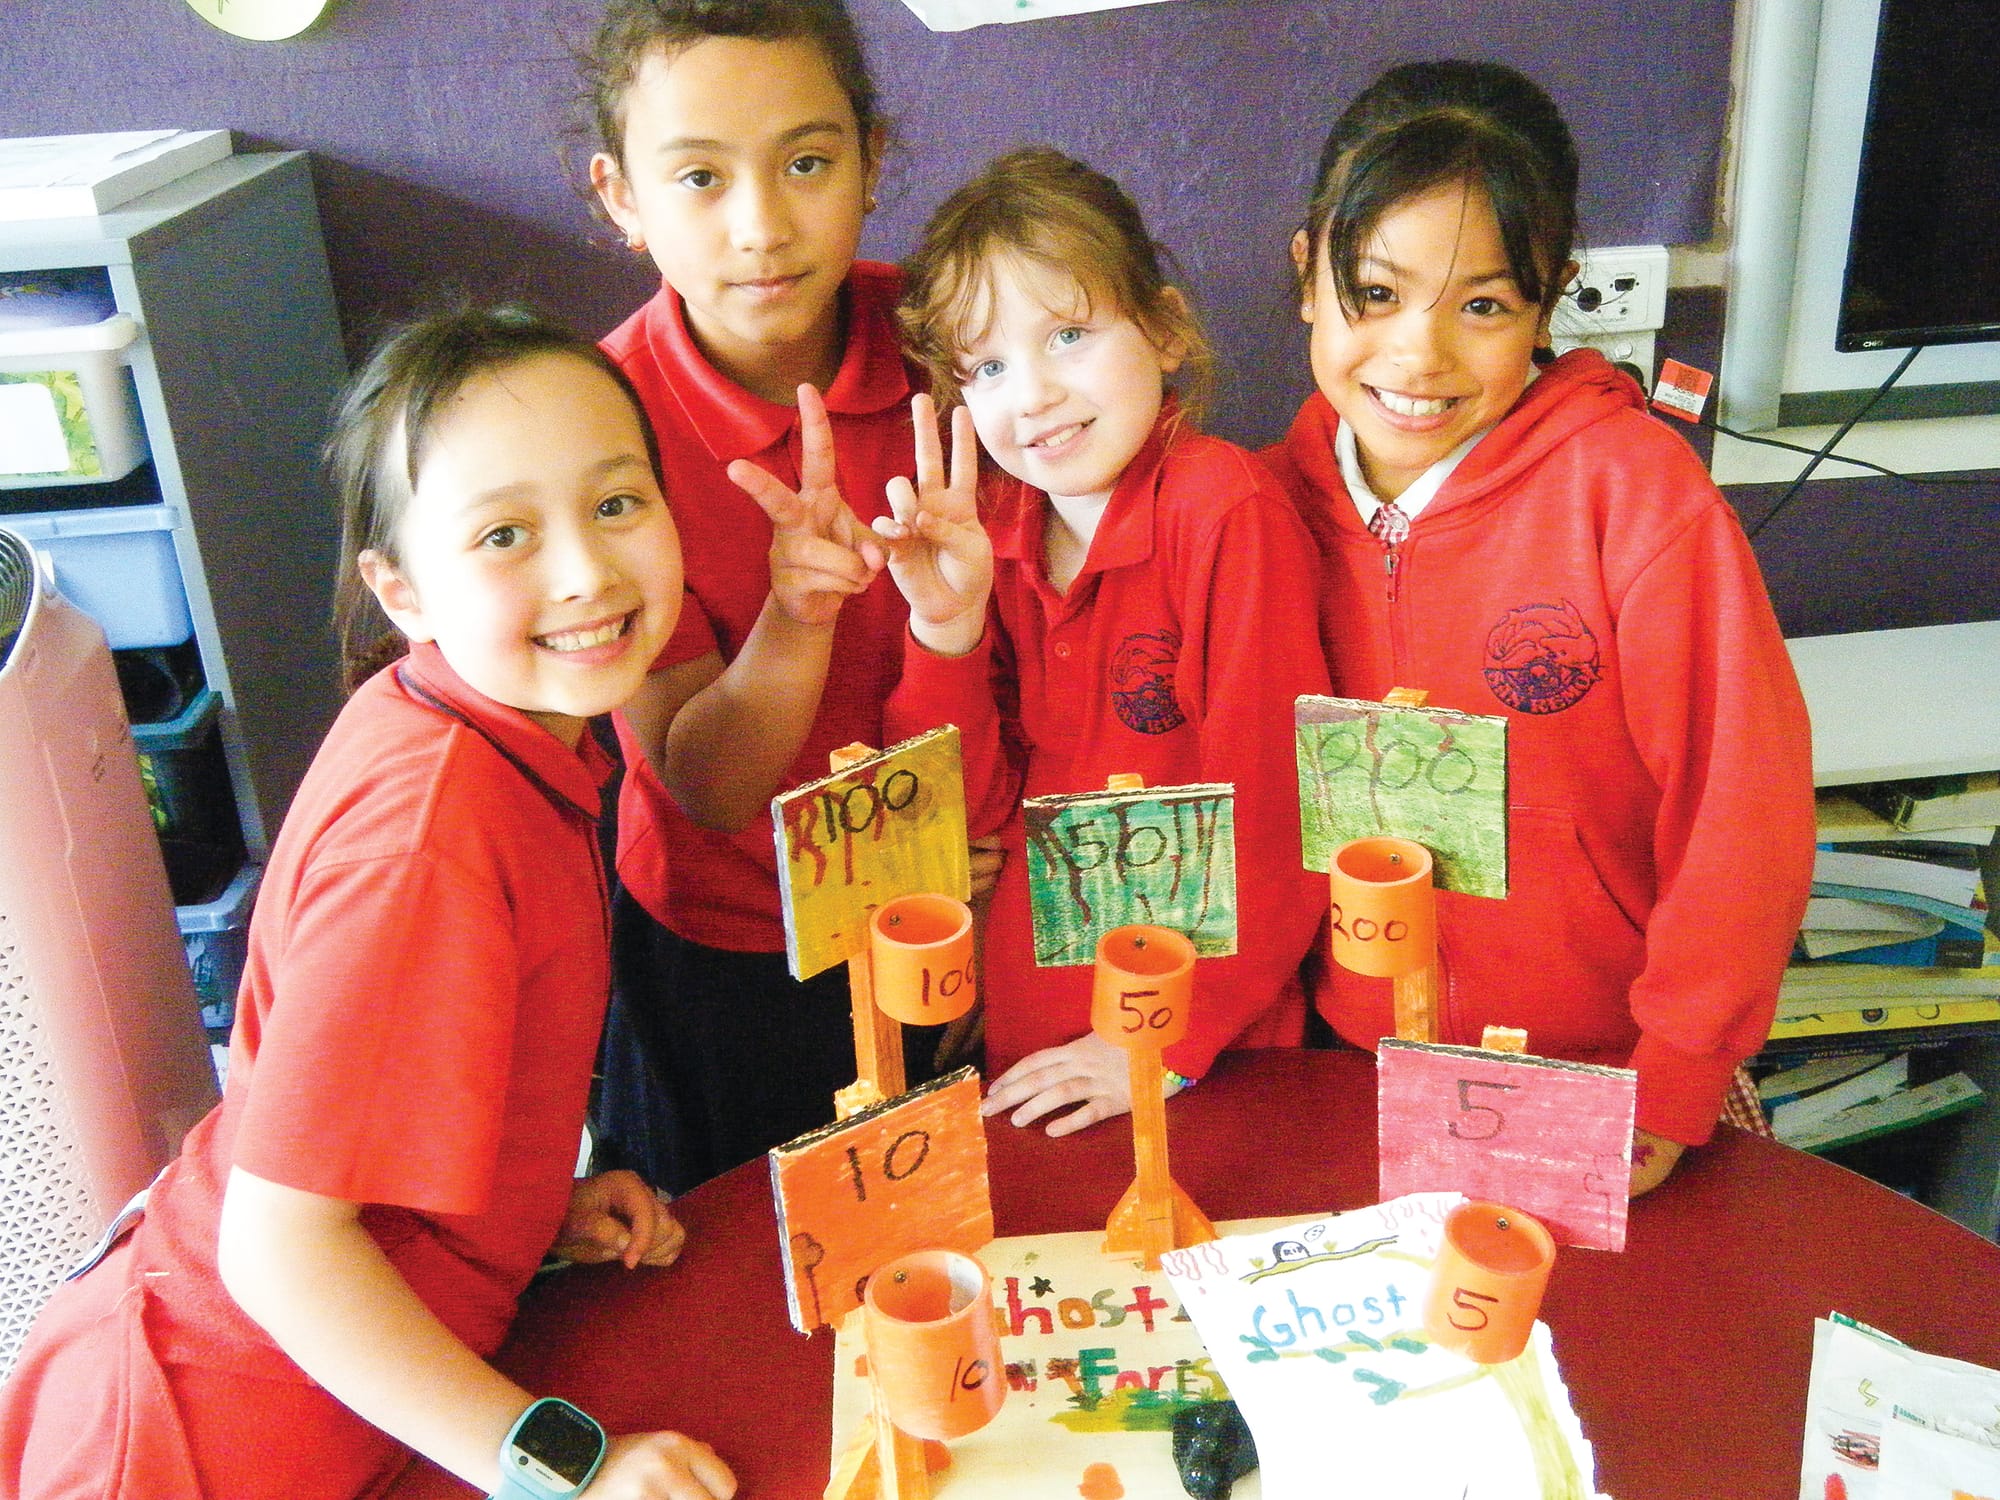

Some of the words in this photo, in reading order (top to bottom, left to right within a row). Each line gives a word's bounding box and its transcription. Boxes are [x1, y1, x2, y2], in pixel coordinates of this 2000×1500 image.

[822, 768, 919, 843] 100
[1066, 819, 1168, 871] 50
[1120, 990, 1173, 1034] 50
[1447, 1078, 1521, 1142] 5
[846, 1130, 931, 1202] 10
[1252, 1284, 1408, 1348] Ghost
[1446, 1286, 1500, 1332] 5
[949, 1355, 990, 1403] 10
